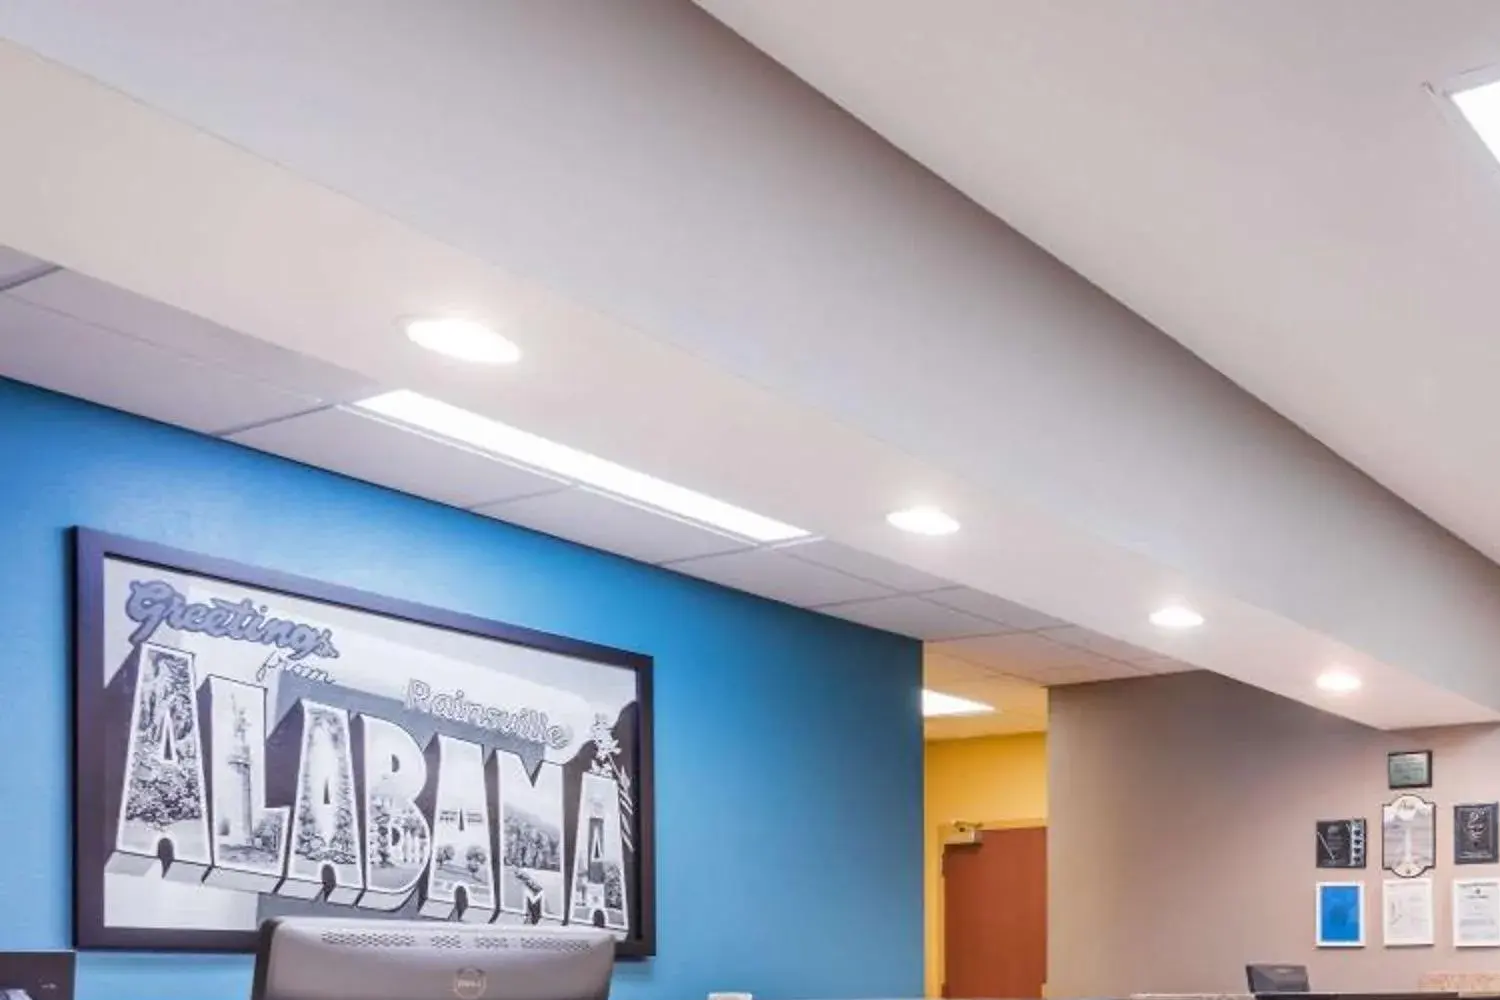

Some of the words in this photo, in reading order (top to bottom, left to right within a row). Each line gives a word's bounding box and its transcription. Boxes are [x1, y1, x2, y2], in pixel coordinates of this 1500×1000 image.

[125, 579, 340, 660] Greetings
[255, 649, 336, 685] from
[404, 677, 573, 750] Rainsville
[115, 642, 630, 932] ALABAMA
